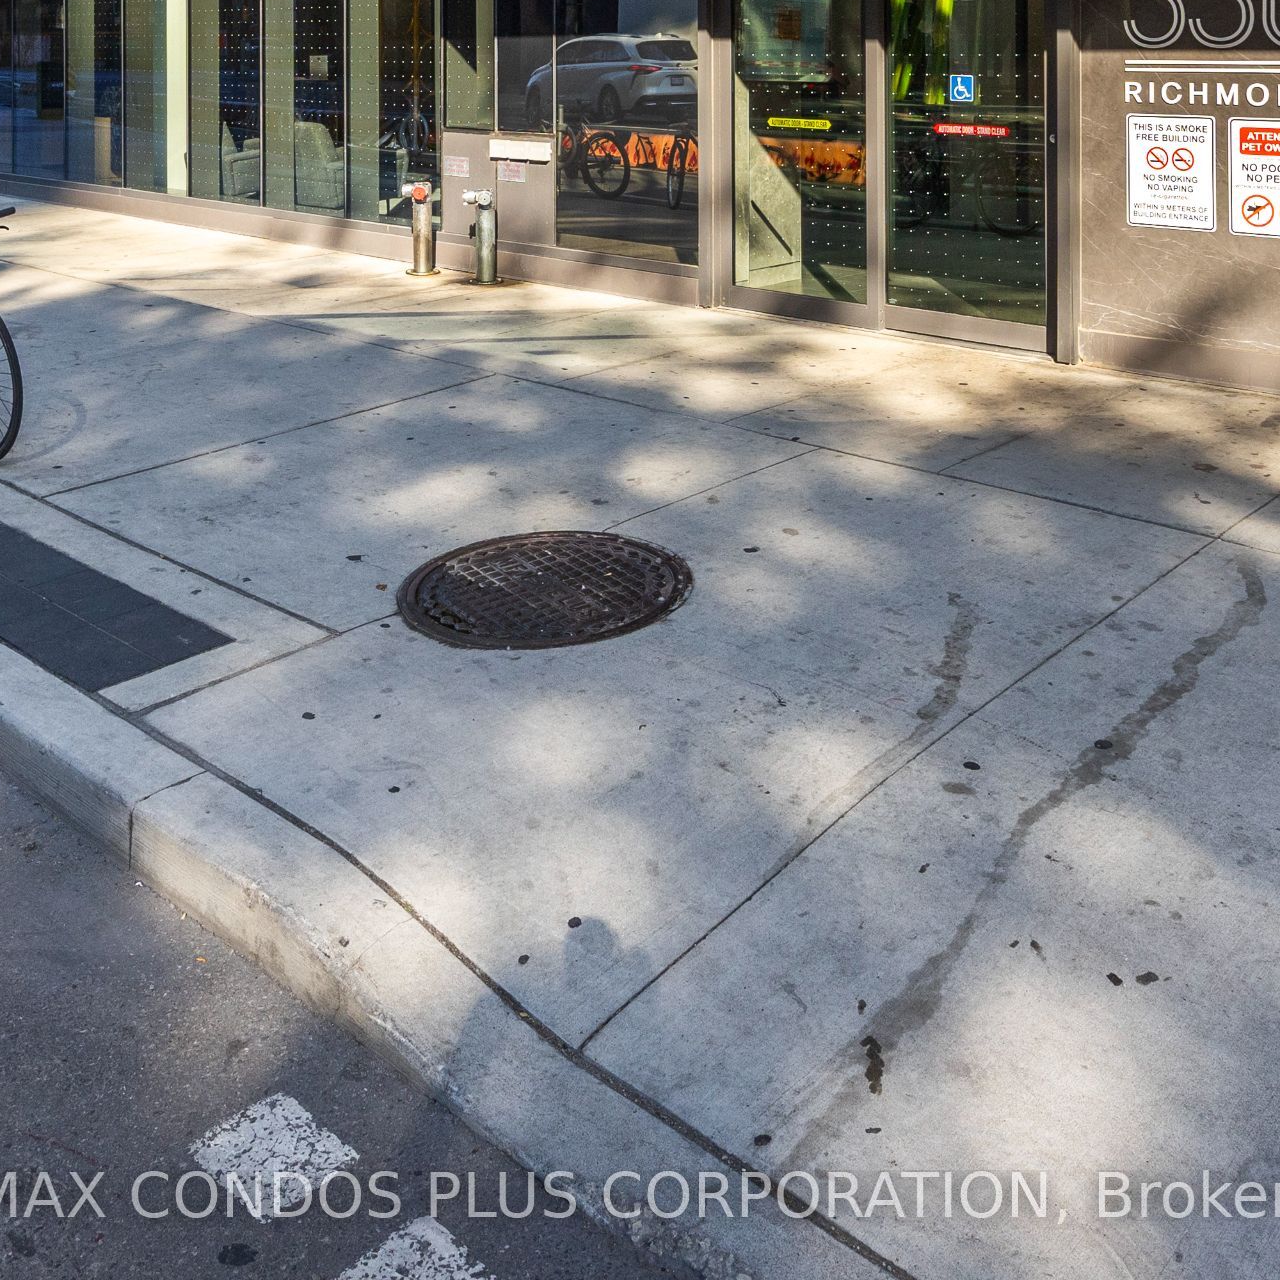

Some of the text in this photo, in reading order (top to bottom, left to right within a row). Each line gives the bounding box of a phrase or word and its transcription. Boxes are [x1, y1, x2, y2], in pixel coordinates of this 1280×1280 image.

[1133, 123, 1208, 133] THIS IS A SMOKE
[1136, 133, 1205, 143] FREE BUILDING
[1241, 143, 1262, 151] PET
[1241, 163, 1258, 172] NO
[1158, 174, 1198, 183] SMOKING
[1246, 173, 1262, 183] NO
[1162, 184, 1194, 193] VAPING
[1133, 202, 1159, 210] WITHIN
[1166, 204, 1196, 213] METERS
[1133, 210, 1208, 222] BUILDING ENTRANCE
